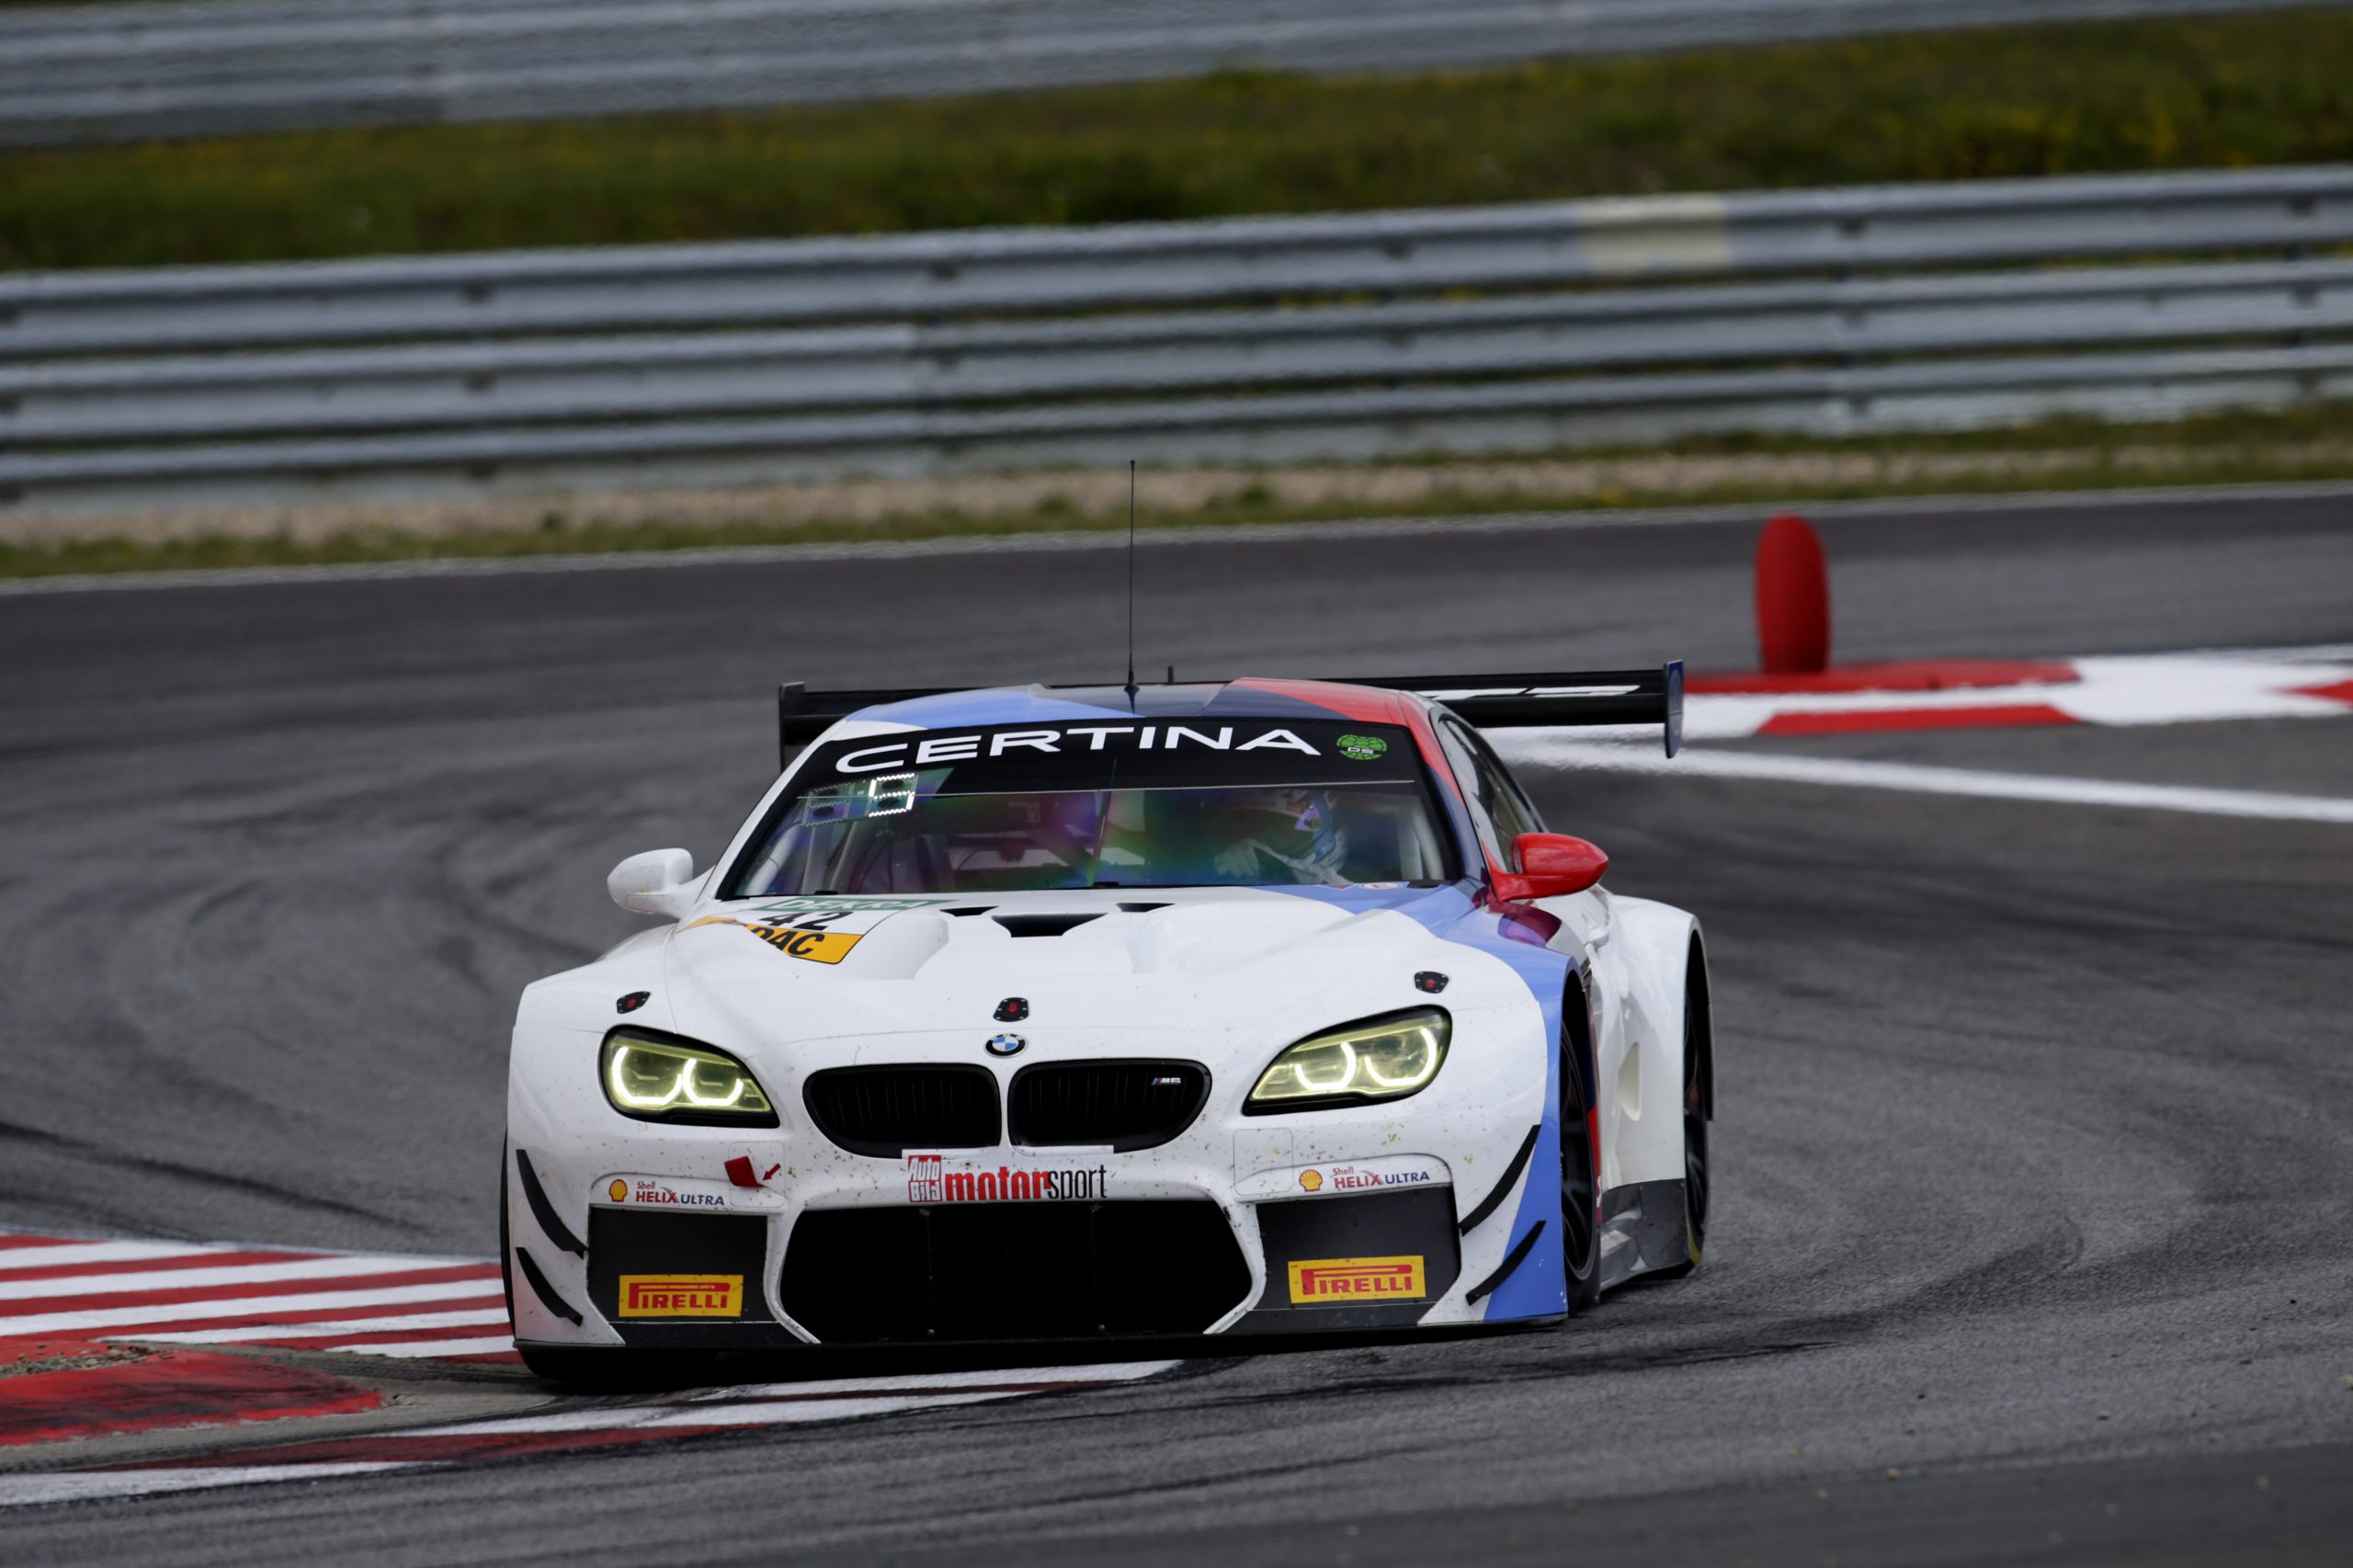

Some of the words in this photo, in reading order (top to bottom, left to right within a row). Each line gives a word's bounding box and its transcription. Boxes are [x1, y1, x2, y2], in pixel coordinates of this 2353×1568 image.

[835, 725, 1321, 773] CERTINA
[757, 911, 854, 931] 42
[750, 926, 825, 956] DAC
[909, 1158, 940, 1181] Auto
[1333, 1166, 1355, 1176] Shell
[1335, 1173, 1382, 1189] HELIX
[1384, 1171, 1430, 1185] ULTRA
[636, 1180, 656, 1190] Shell
[910, 1182, 940, 1201] Bild
[945, 1165, 1108, 1201] motorsport
[635, 1189, 678, 1204] HELIX
[680, 1194, 725, 1206] ULTRA
[1301, 1265, 1413, 1295] PIRELLI
[629, 1282, 731, 1309] PIRELLI
